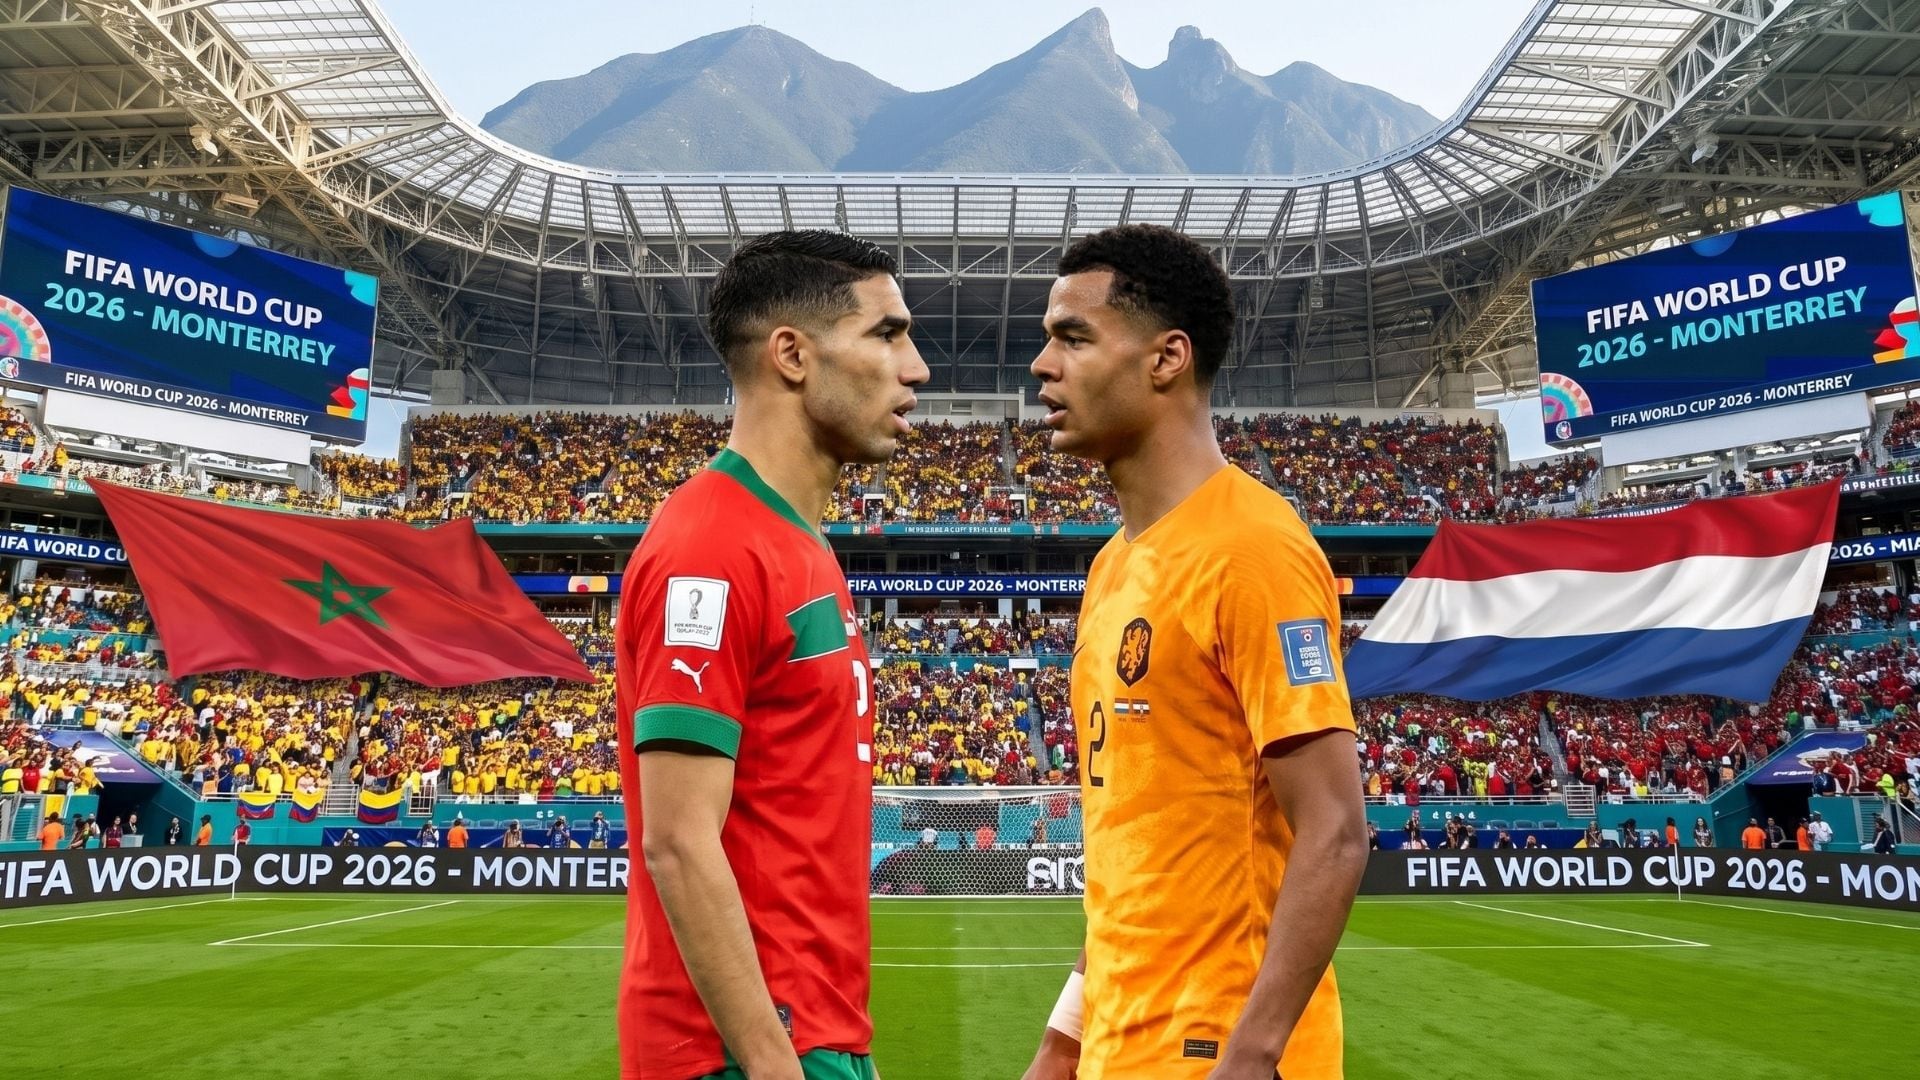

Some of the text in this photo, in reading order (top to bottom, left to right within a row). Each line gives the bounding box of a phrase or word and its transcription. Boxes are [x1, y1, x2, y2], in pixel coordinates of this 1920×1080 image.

[65, 250, 322, 329] FIFA WORLD CUP
[1587, 257, 1846, 332] FIFA WORLD CUP
[44, 283, 124, 322] 2026
[152, 306, 335, 366] MONTERREY
[1578, 332, 1646, 368] 2026
[1672, 287, 1867, 349] MONTERREY
[66, 372, 95, 389] FIFA
[100, 378, 151, 398] WORLD
[156, 388, 182, 404] CUP
[186, 394, 218, 410] 2026
[229, 402, 308, 426] MONTERREY
[1611, 413, 1637, 427] FIFA
[1640, 402, 1686, 421] WORLD
[1690, 398, 1716, 413] CUP
[1719, 392, 1751, 408] 2026
[1764, 374, 1852, 400] MONTERREY
[0, 536, 28, 550] IFA
[34, 539, 100, 558] WORLD
[1831, 542, 1874, 560] 2026
[848, 580, 877, 591] FIFA
[880, 580, 933, 591] WORLD
[936, 580, 964, 591] CUP
[968, 580, 1003, 591] 2026
[1087, 701, 1106, 787] 2
[0, 859, 73, 898] IFA
[88, 854, 241, 892] WORLD
[254, 854, 332, 885] CUP
[344, 855, 435, 886] 2026
[1408, 858, 1486, 887] FIFA
[1495, 856, 1632, 887] WORLD
[1644, 856, 1714, 887] CUP
[1727, 858, 1805, 893] 2026
